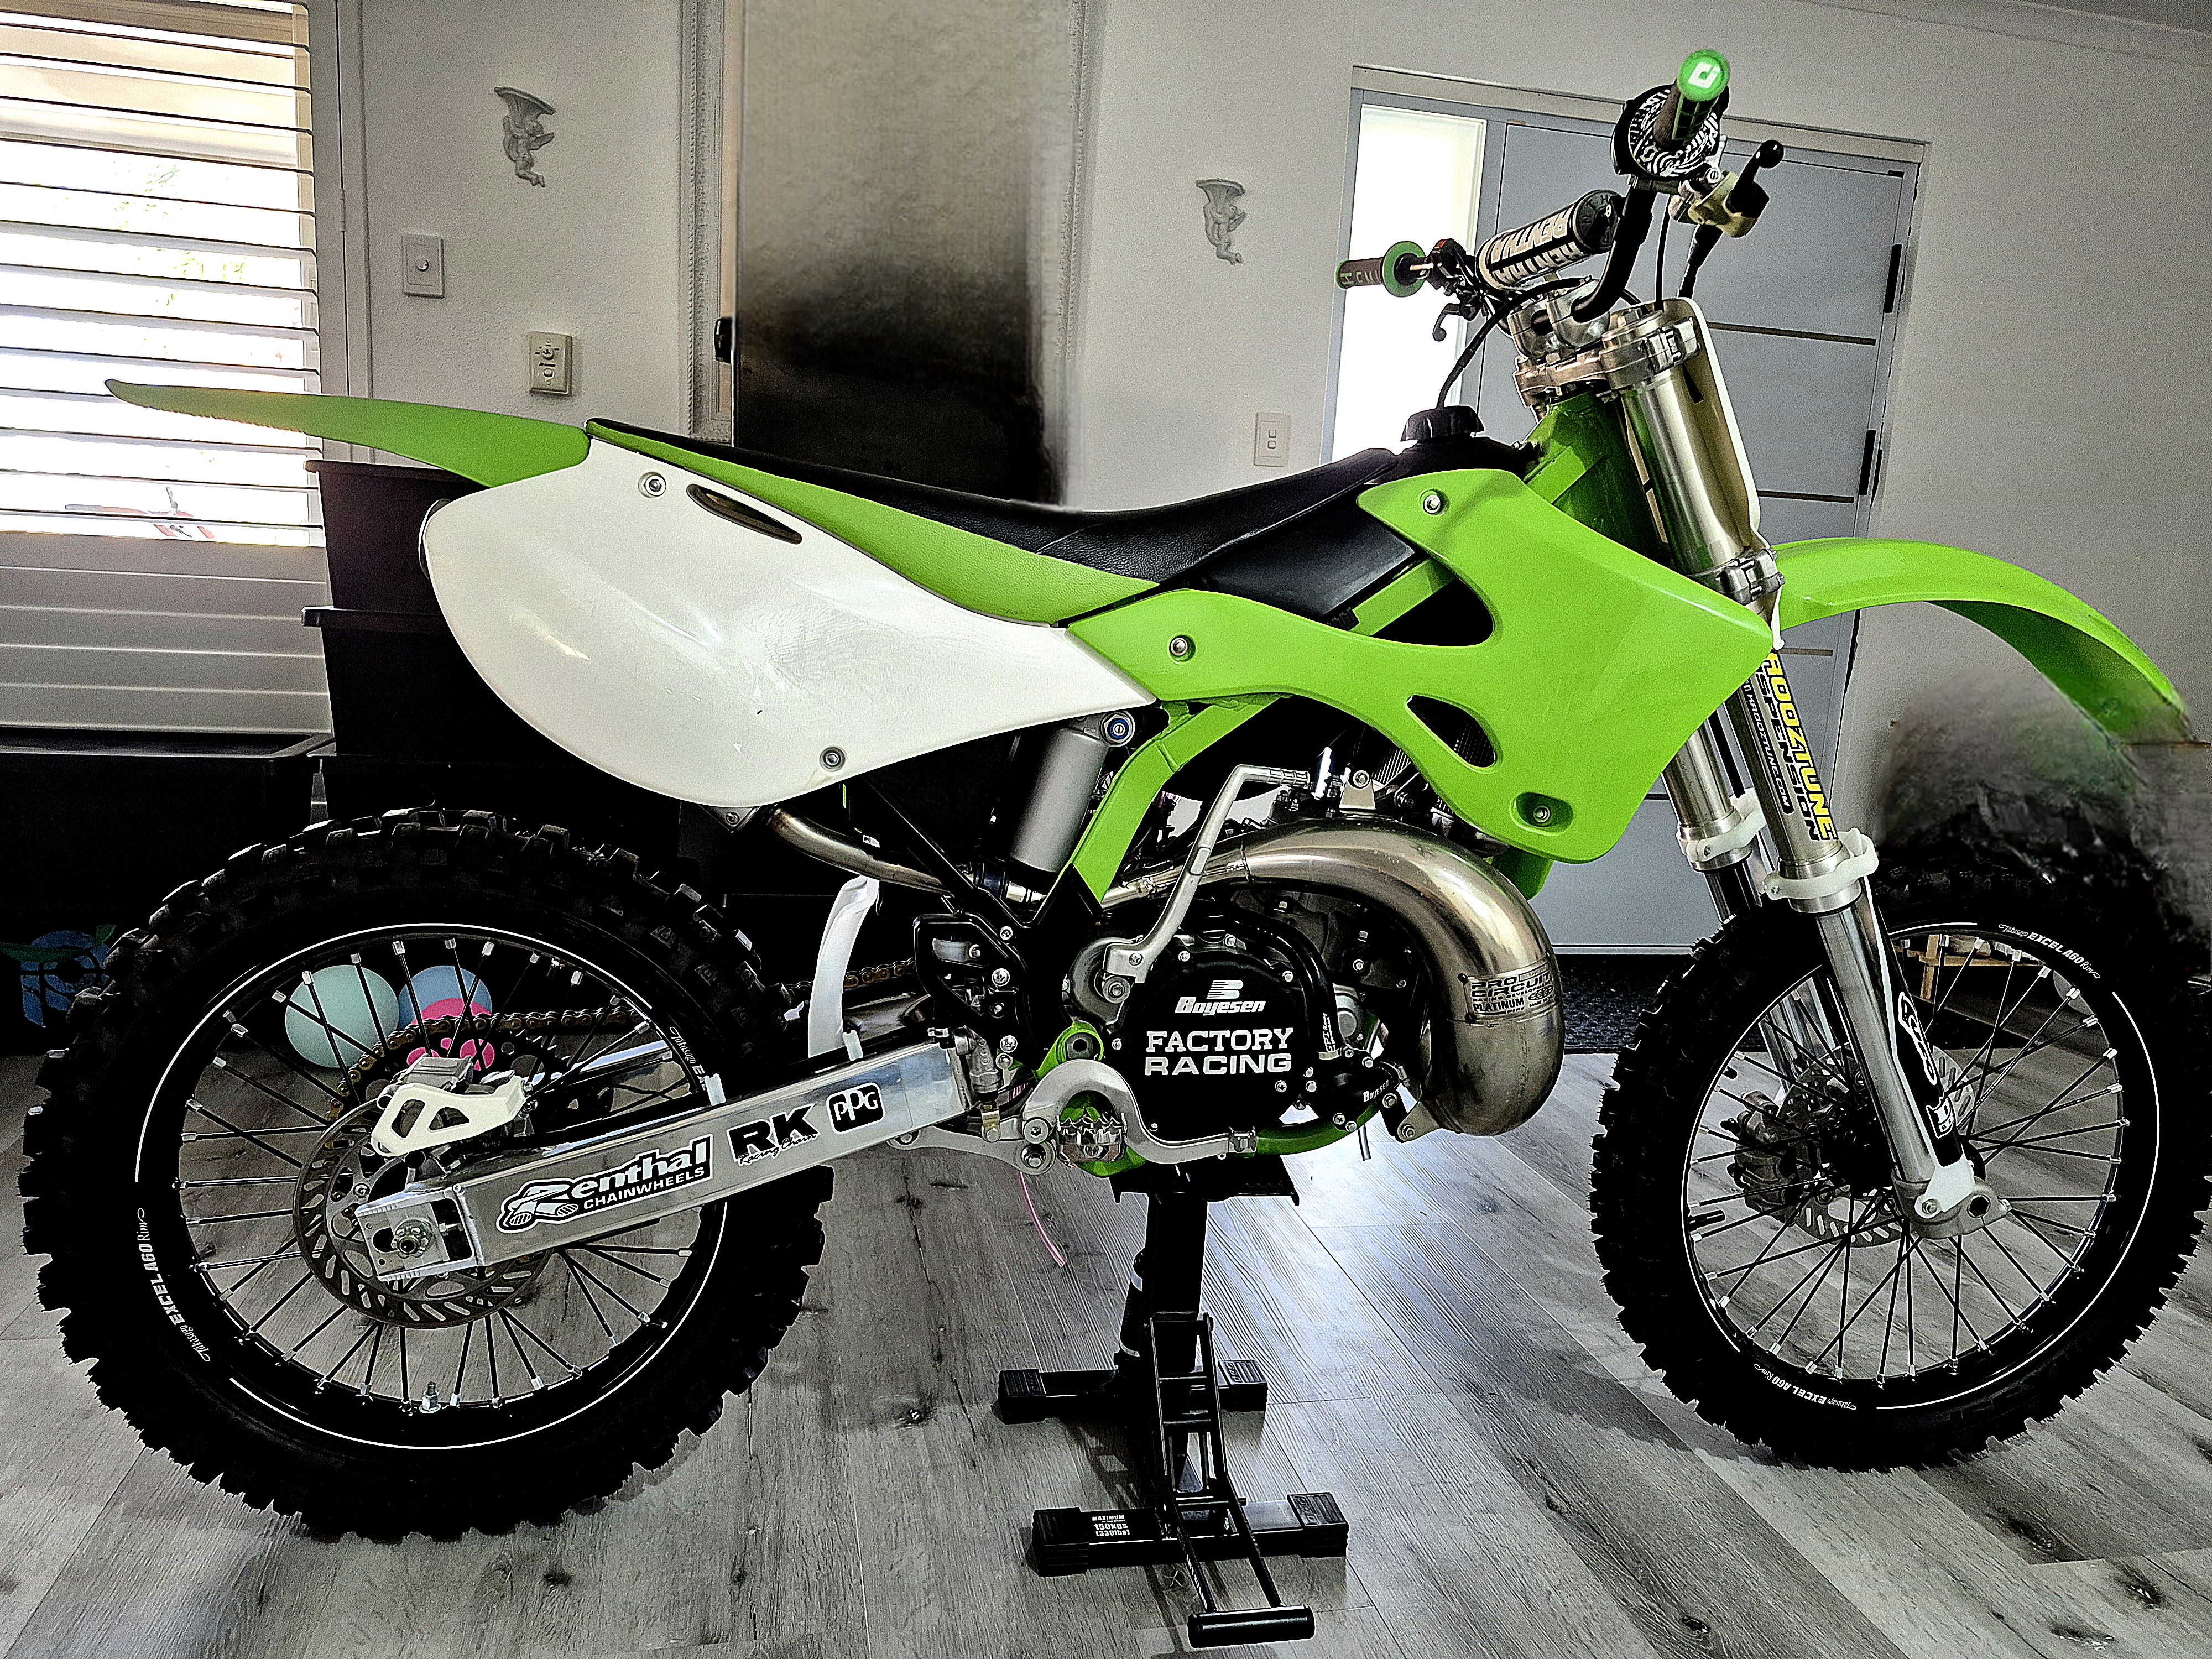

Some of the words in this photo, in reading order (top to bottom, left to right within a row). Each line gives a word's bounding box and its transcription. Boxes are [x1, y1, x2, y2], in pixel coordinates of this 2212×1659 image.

[1745, 693, 1790, 808] KROOZTUNE.COM
[1757, 668, 1819, 841] SPENSION
[2027, 932, 2064, 953] EXCEL
[2062, 950, 2084, 964] A60
[2080, 961, 2100, 979] Rim
[1472, 977, 1517, 989] PRO
[1472, 971, 1550, 997] CIRCUIT
[1175, 997, 1266, 1016] Boyesen
[1473, 997, 1524, 1011] PLATINUM
[1146, 1027, 1293, 1052] FACTORY
[1145, 1053, 1292, 1076] RACING
[1363, 1079, 1389, 1102] Boyesen
[833, 1089, 879, 1121] PPG
[729, 1105, 819, 1159] RK
[738, 1146, 779, 1164] Racing
[781, 1134, 817, 1150] Chain
[503, 1141, 707, 1226] Renthal
[584, 1167, 705, 1209] CHAINWHEELS
[137, 1207, 150, 1241] Rim
[138, 1243, 159, 1271] A60
[150, 1274, 186, 1325] EXCEL
[1754, 1364, 1773, 1381] Rim
[1772, 1376, 1792, 1390] A60
[1792, 1385, 1827, 1404] EXCEL
